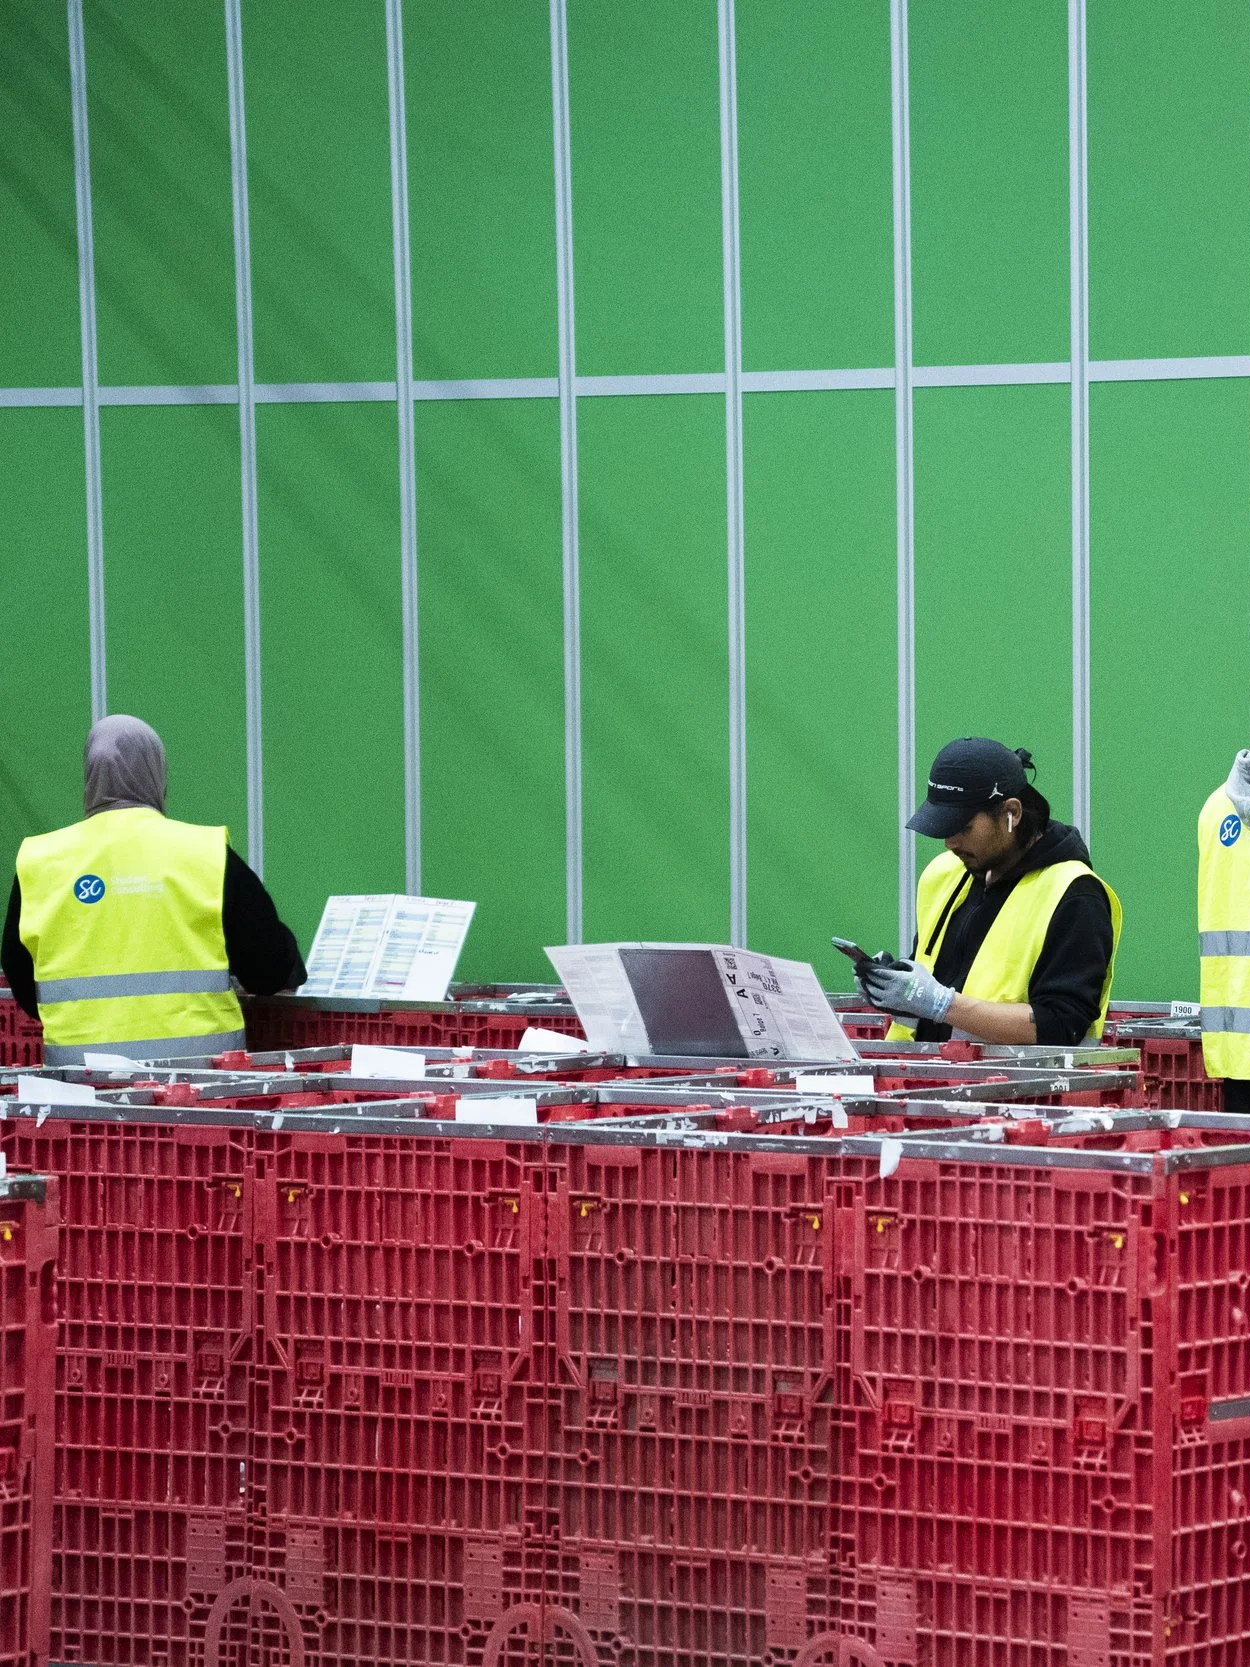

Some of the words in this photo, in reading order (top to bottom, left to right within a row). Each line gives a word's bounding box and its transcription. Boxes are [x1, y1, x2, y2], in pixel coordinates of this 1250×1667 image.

[1220, 819, 1240, 842] SC
[77, 878, 102, 900] SC
[1174, 1005, 1193, 1014] 1900
